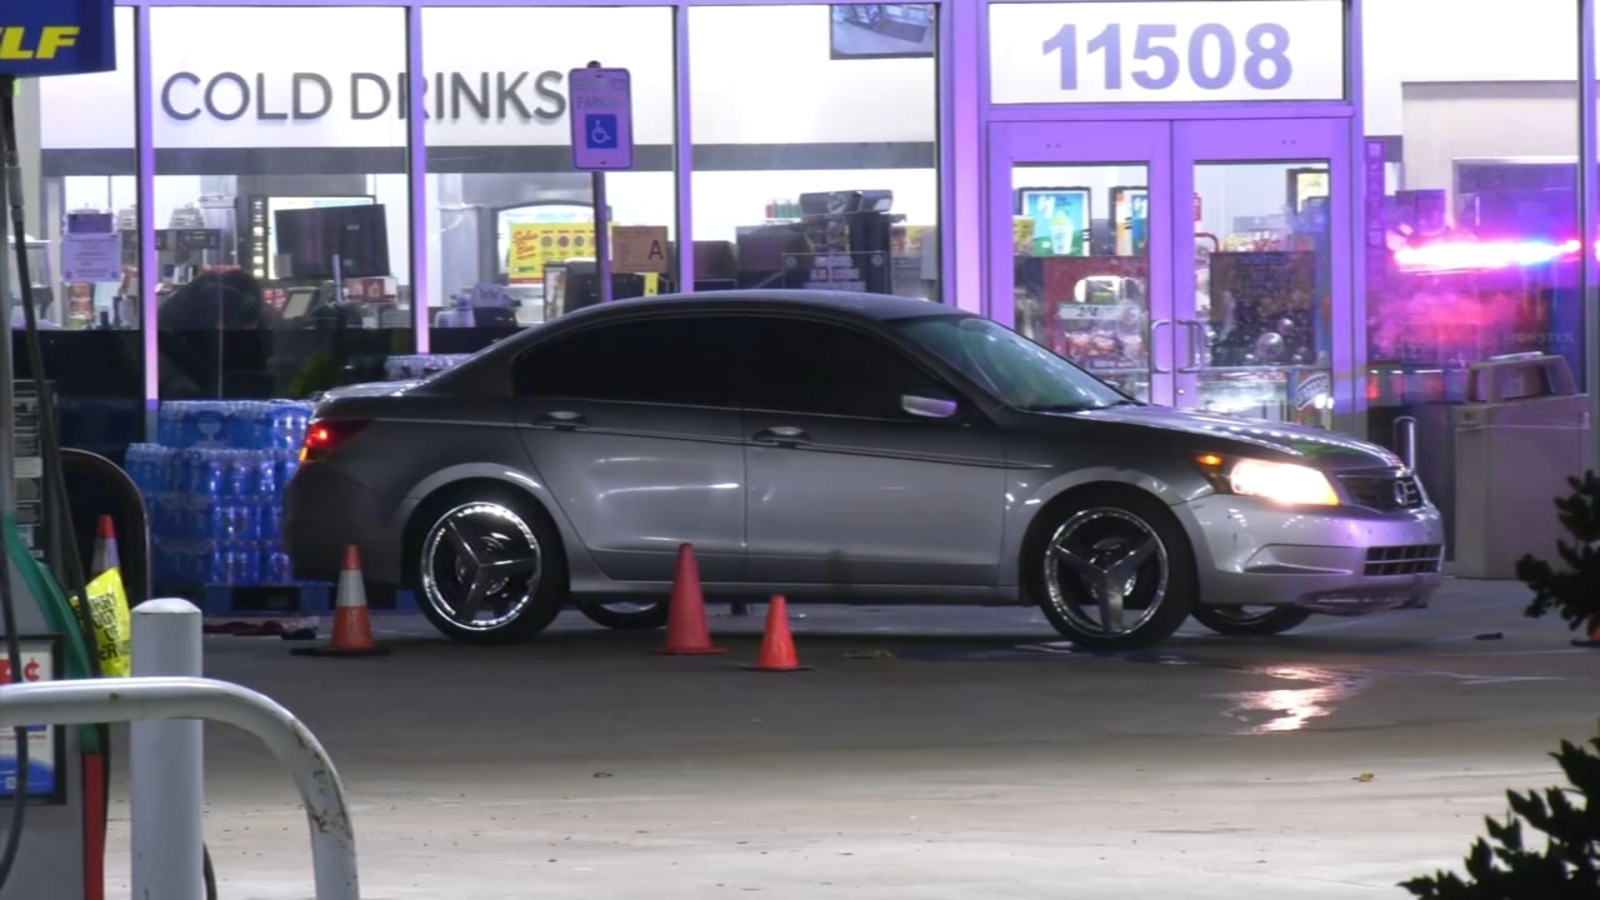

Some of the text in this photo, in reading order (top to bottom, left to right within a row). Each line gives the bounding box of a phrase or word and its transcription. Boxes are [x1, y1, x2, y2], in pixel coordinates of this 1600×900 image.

[0, 26, 81, 59] LF
[1042, 22, 1293, 90] 11508
[161, 71, 566, 121] COLD DRINKS
[648, 240, 664, 260] A
